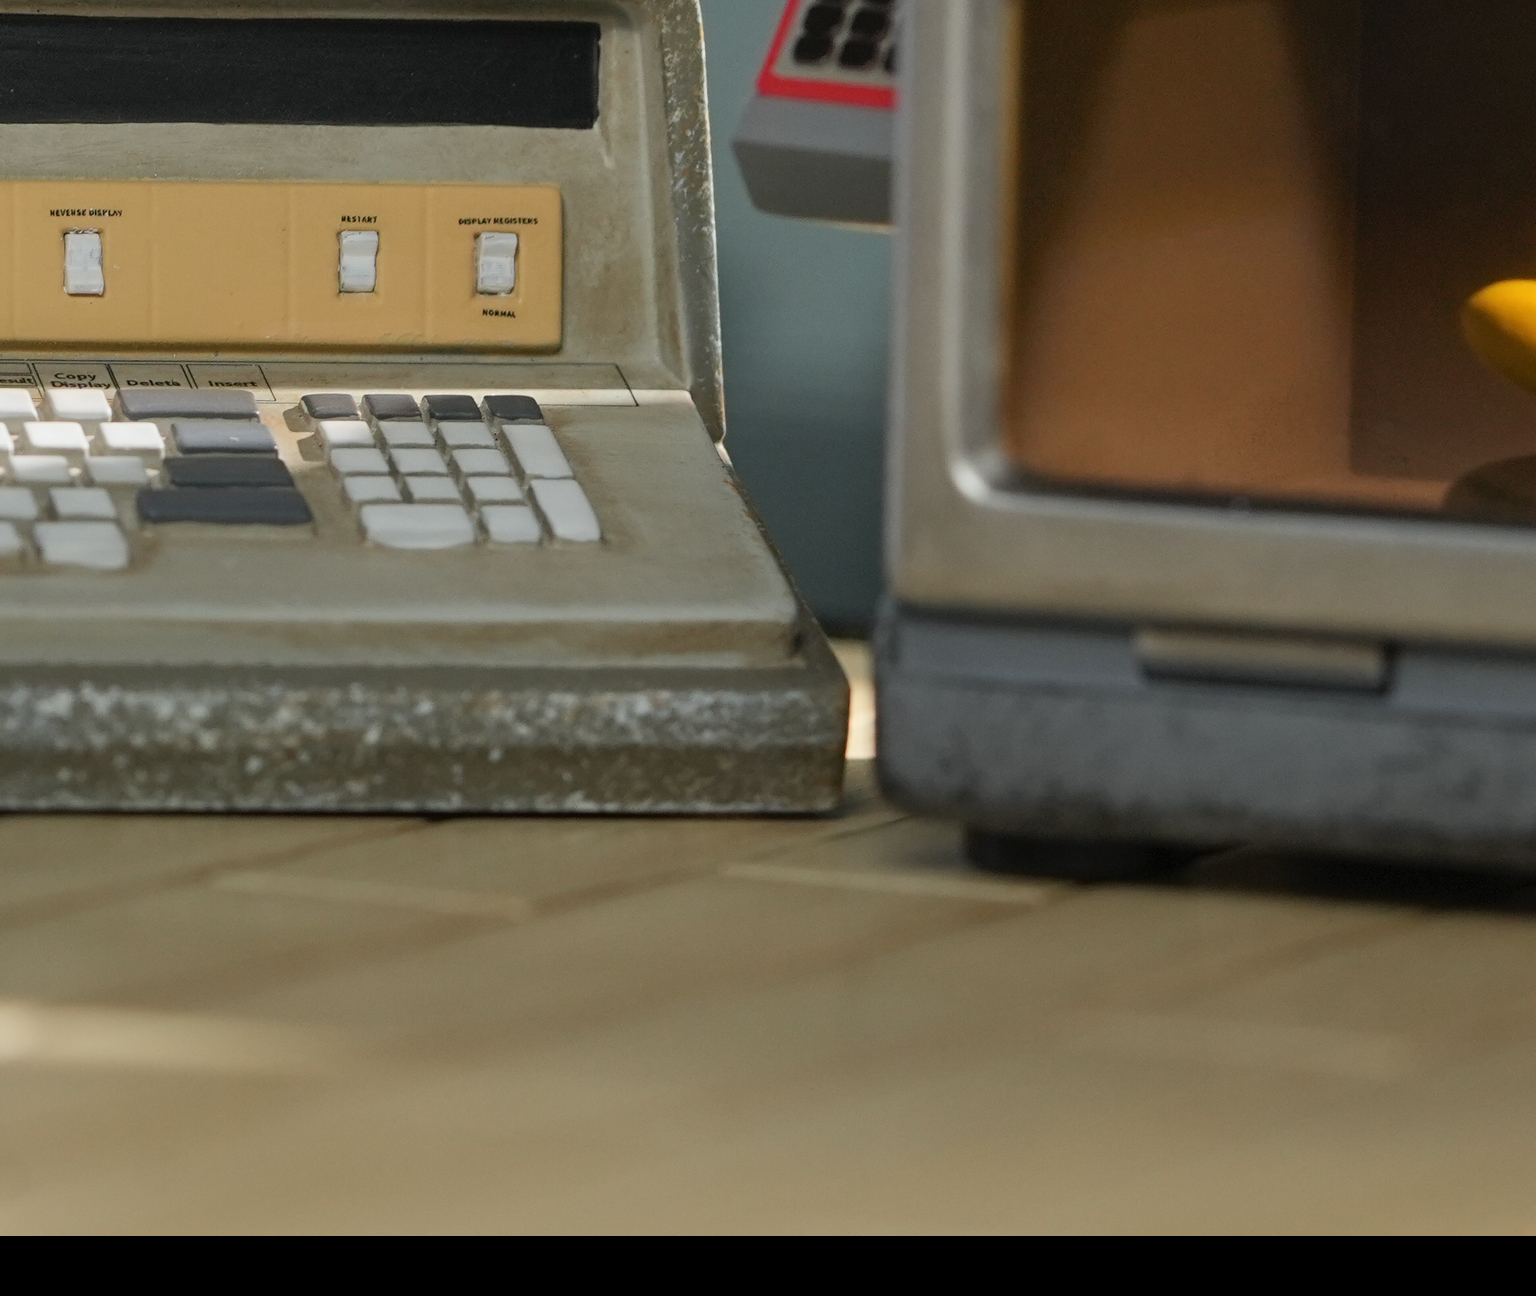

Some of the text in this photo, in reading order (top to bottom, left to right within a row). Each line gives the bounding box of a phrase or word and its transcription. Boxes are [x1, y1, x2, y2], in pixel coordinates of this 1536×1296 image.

[88, 209, 123, 217] DISPLAY
[341, 215, 378, 223] RESTART
[458, 216, 539, 225] DISPLAY REGISTERS
[482, 308, 516, 318] NORMAL
[54, 372, 97, 383] Copy
[51, 380, 112, 389] Display
[208, 379, 258, 388] Insert
